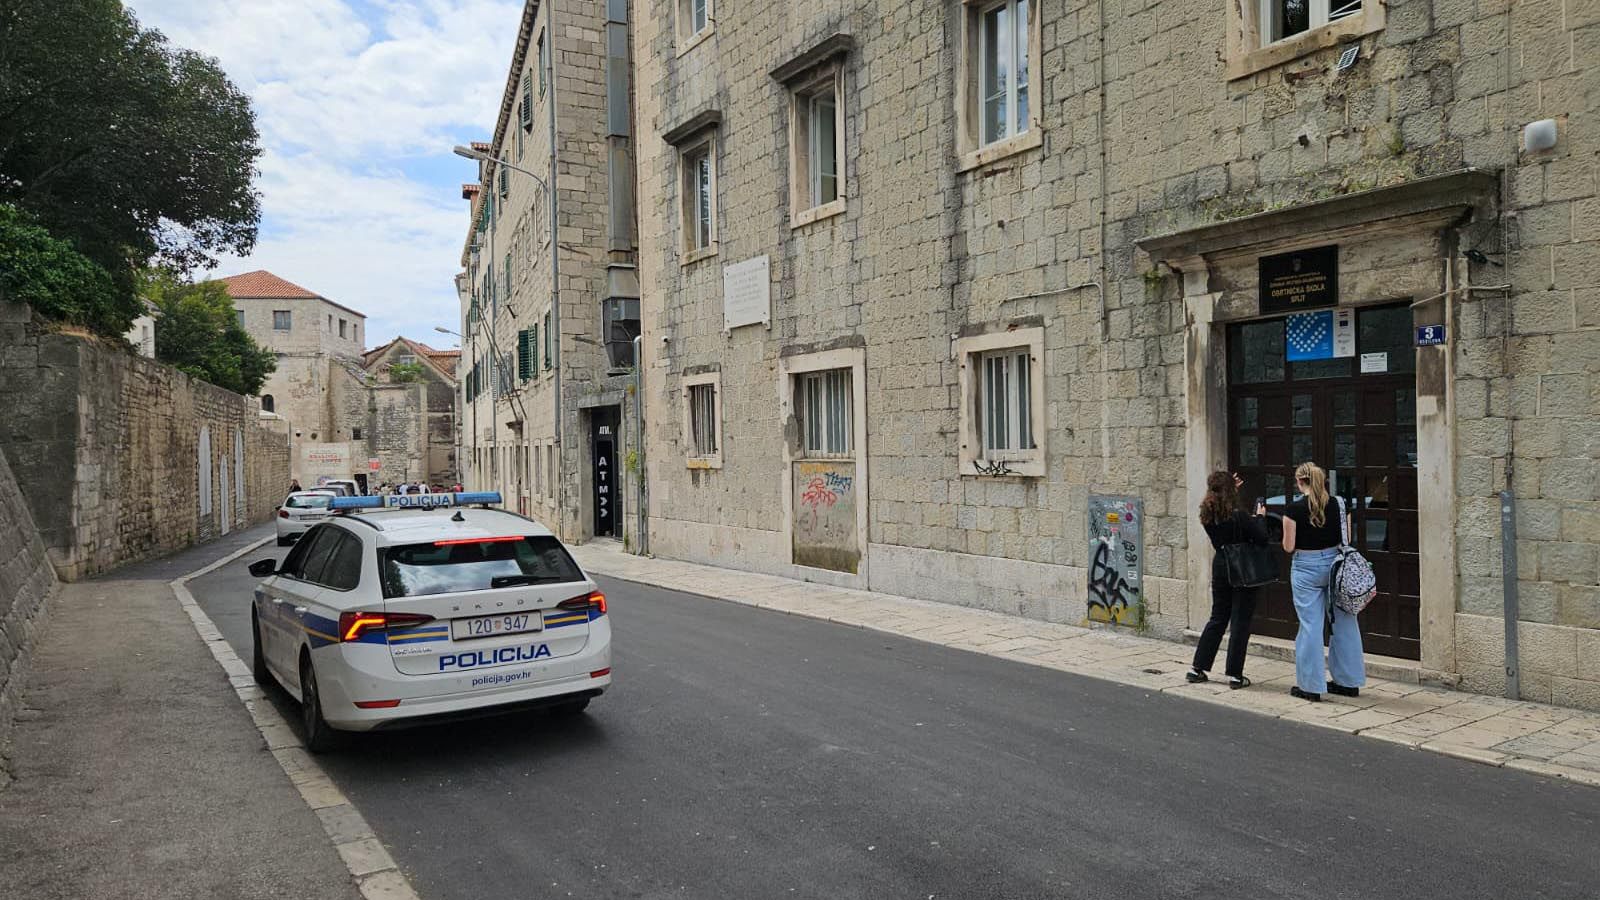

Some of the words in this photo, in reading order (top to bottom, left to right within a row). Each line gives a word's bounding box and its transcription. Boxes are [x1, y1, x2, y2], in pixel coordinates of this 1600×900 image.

[1425, 327, 1434, 340] 3
[389, 495, 451, 507] POLICIJA
[467, 618, 493, 635] 120
[504, 615, 529, 631] 947
[439, 643, 552, 671] POLICIJA
[471, 670, 532, 687] policija.gov.hr
